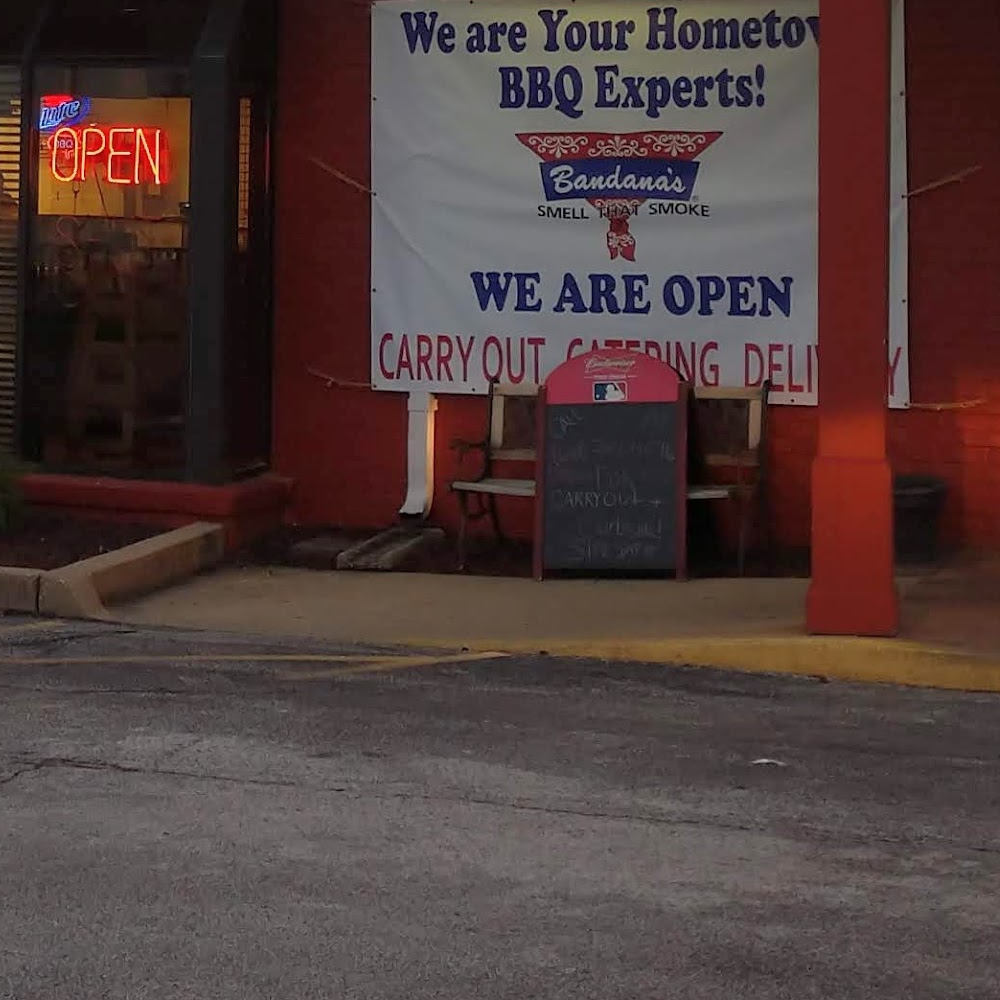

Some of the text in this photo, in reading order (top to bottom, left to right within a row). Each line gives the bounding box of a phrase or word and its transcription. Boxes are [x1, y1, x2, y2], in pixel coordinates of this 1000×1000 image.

[400, 7, 819, 53] We are Your Hometo
[499, 64, 765, 119] BBQ Experts!
[52, 127, 162, 185] OPEN
[550, 165, 687, 194] Bandana's
[537, 202, 710, 220] SMELL THAT SMOKE
[470, 271, 794, 317] WE ARE OPEN
